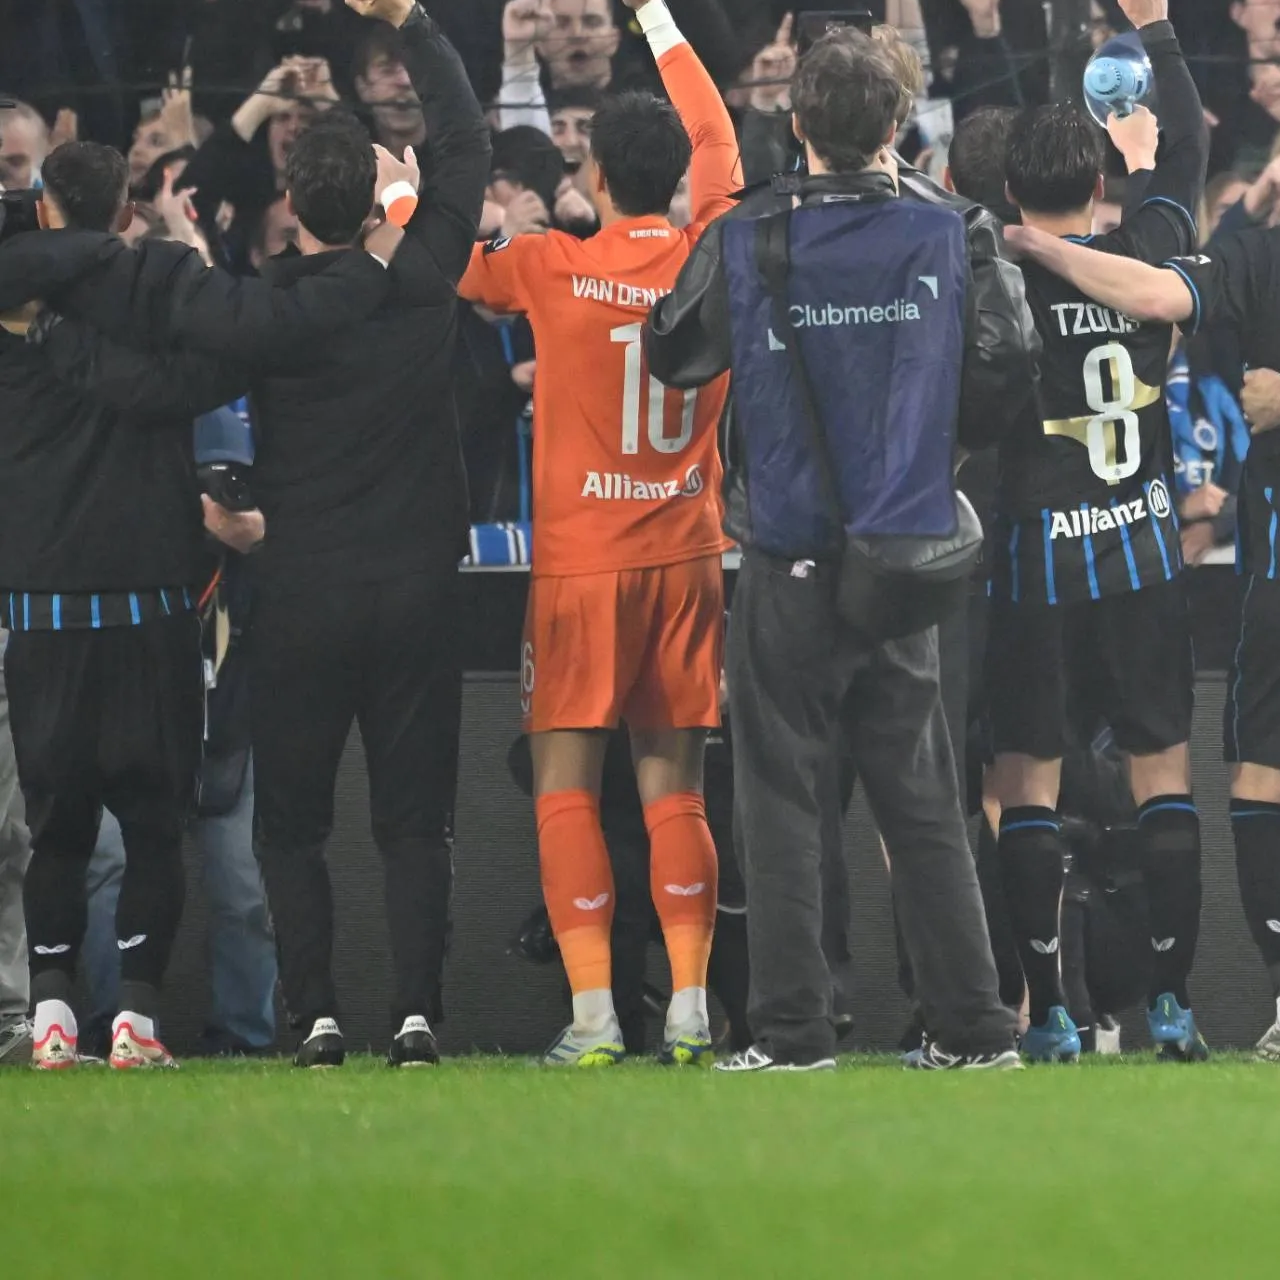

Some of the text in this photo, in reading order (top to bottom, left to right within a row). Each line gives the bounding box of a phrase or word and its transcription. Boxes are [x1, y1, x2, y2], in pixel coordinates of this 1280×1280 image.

[571, 274, 658, 308] VAN DEN
[788, 298, 921, 328] Clubmedia
[1083, 342, 1141, 481] 8
[581, 471, 680, 500] Allianz
[1050, 495, 1148, 540] Allianz
